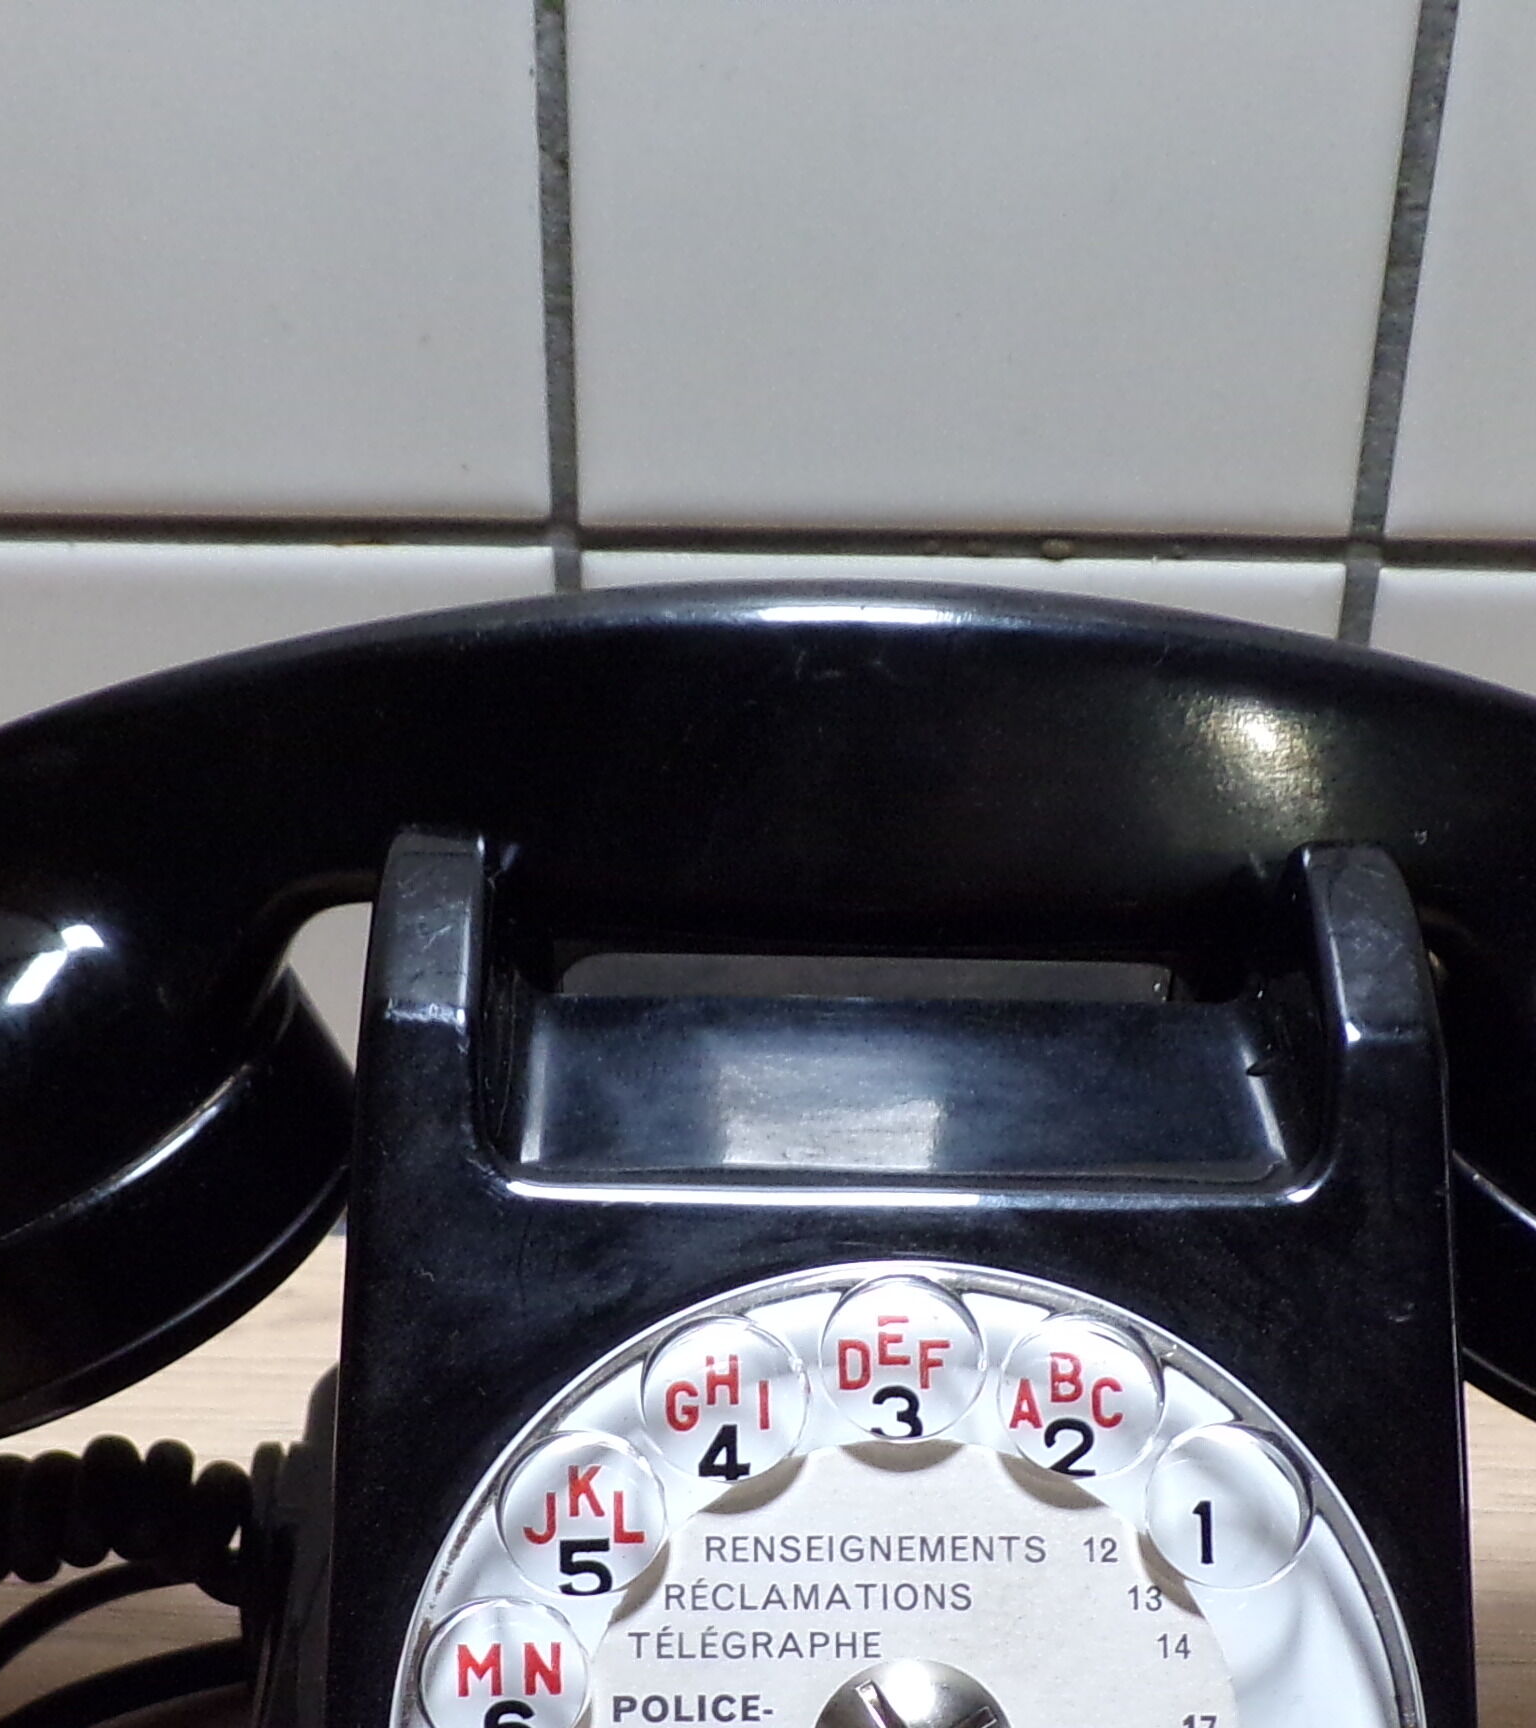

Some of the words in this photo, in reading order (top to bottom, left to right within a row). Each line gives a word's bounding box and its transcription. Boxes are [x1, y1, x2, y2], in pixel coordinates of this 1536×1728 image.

[869, 1385, 924, 1438] 3
[698, 1424, 751, 1481] 4
[1043, 1417, 1096, 1476] 2
[704, 1534, 1047, 1564] RENSEIGNEMENTS
[1083, 1536, 1119, 1563] 12
[1193, 1500, 1214, 1565] 1
[558, 1537, 613, 1596] 5
[664, 1577, 972, 1611] RÉCLAMATIONS
[1127, 1584, 1163, 1612] 13
[628, 1625, 882, 1660] TÉLÉGRAPHE
[1158, 1633, 1191, 1660] 14
[613, 1694, 773, 1723] POLICE-
